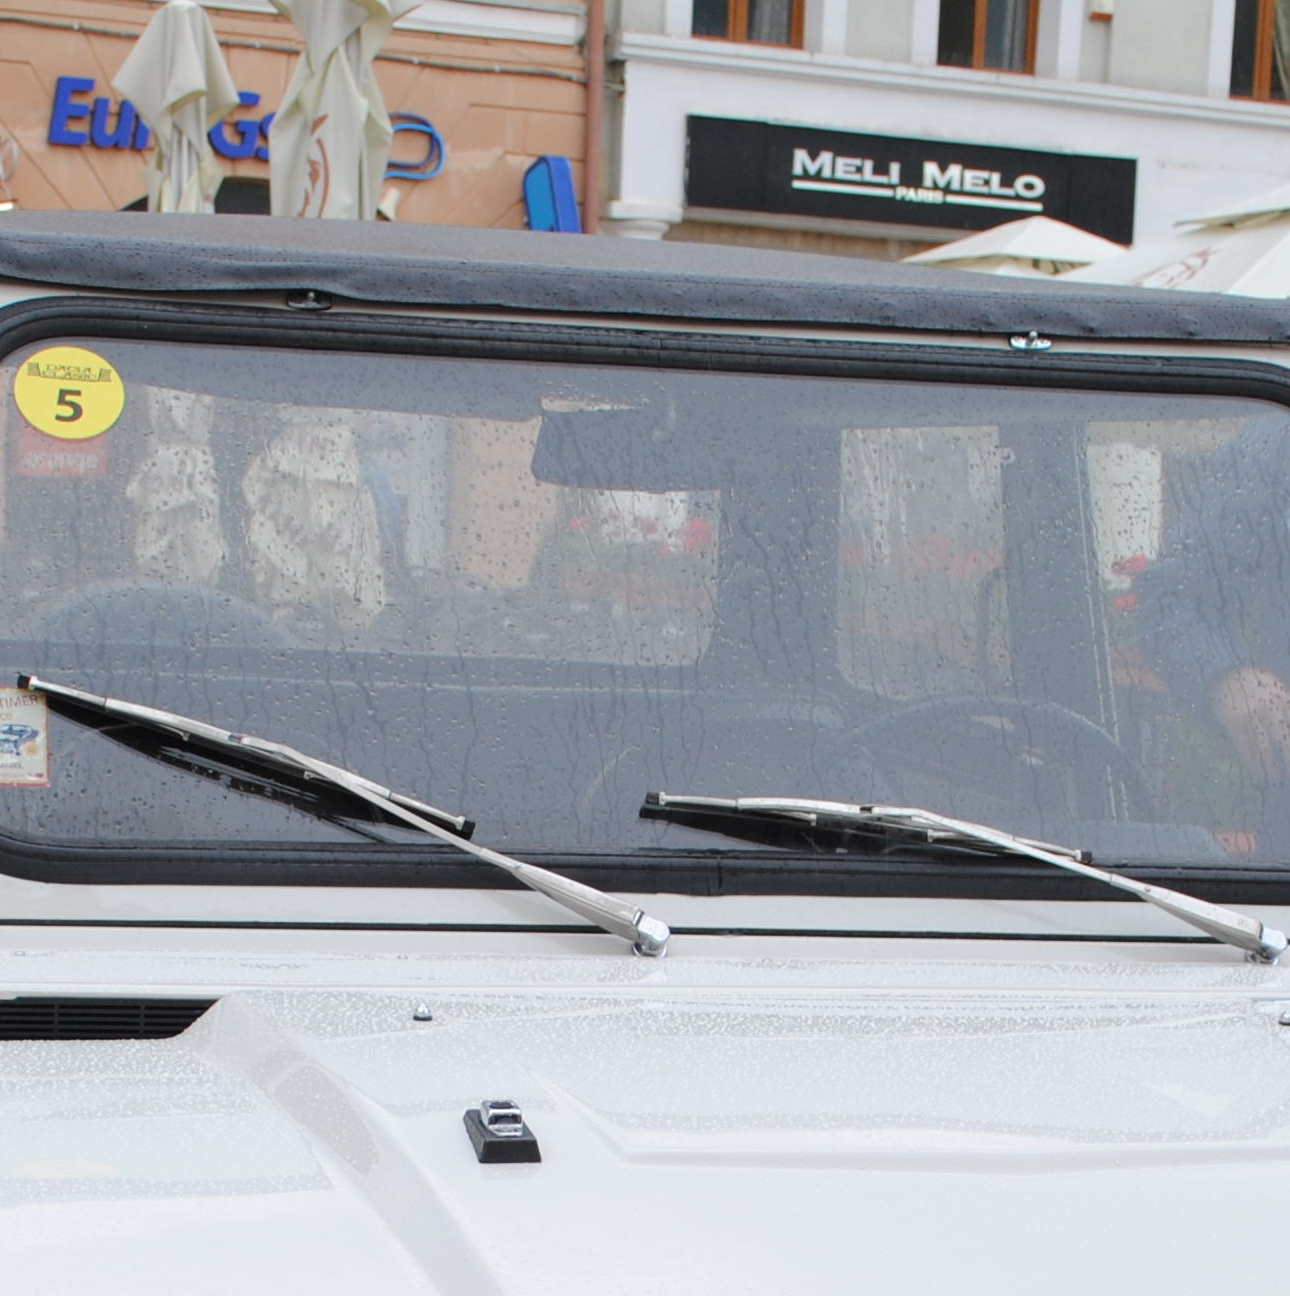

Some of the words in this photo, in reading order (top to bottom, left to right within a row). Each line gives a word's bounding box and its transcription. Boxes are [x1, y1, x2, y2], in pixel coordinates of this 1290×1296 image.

[792, 148, 901, 186] MELI
[922, 161, 1046, 199] MELO
[894, 186, 944, 204] PARIS
[54, 388, 83, 423] 5
